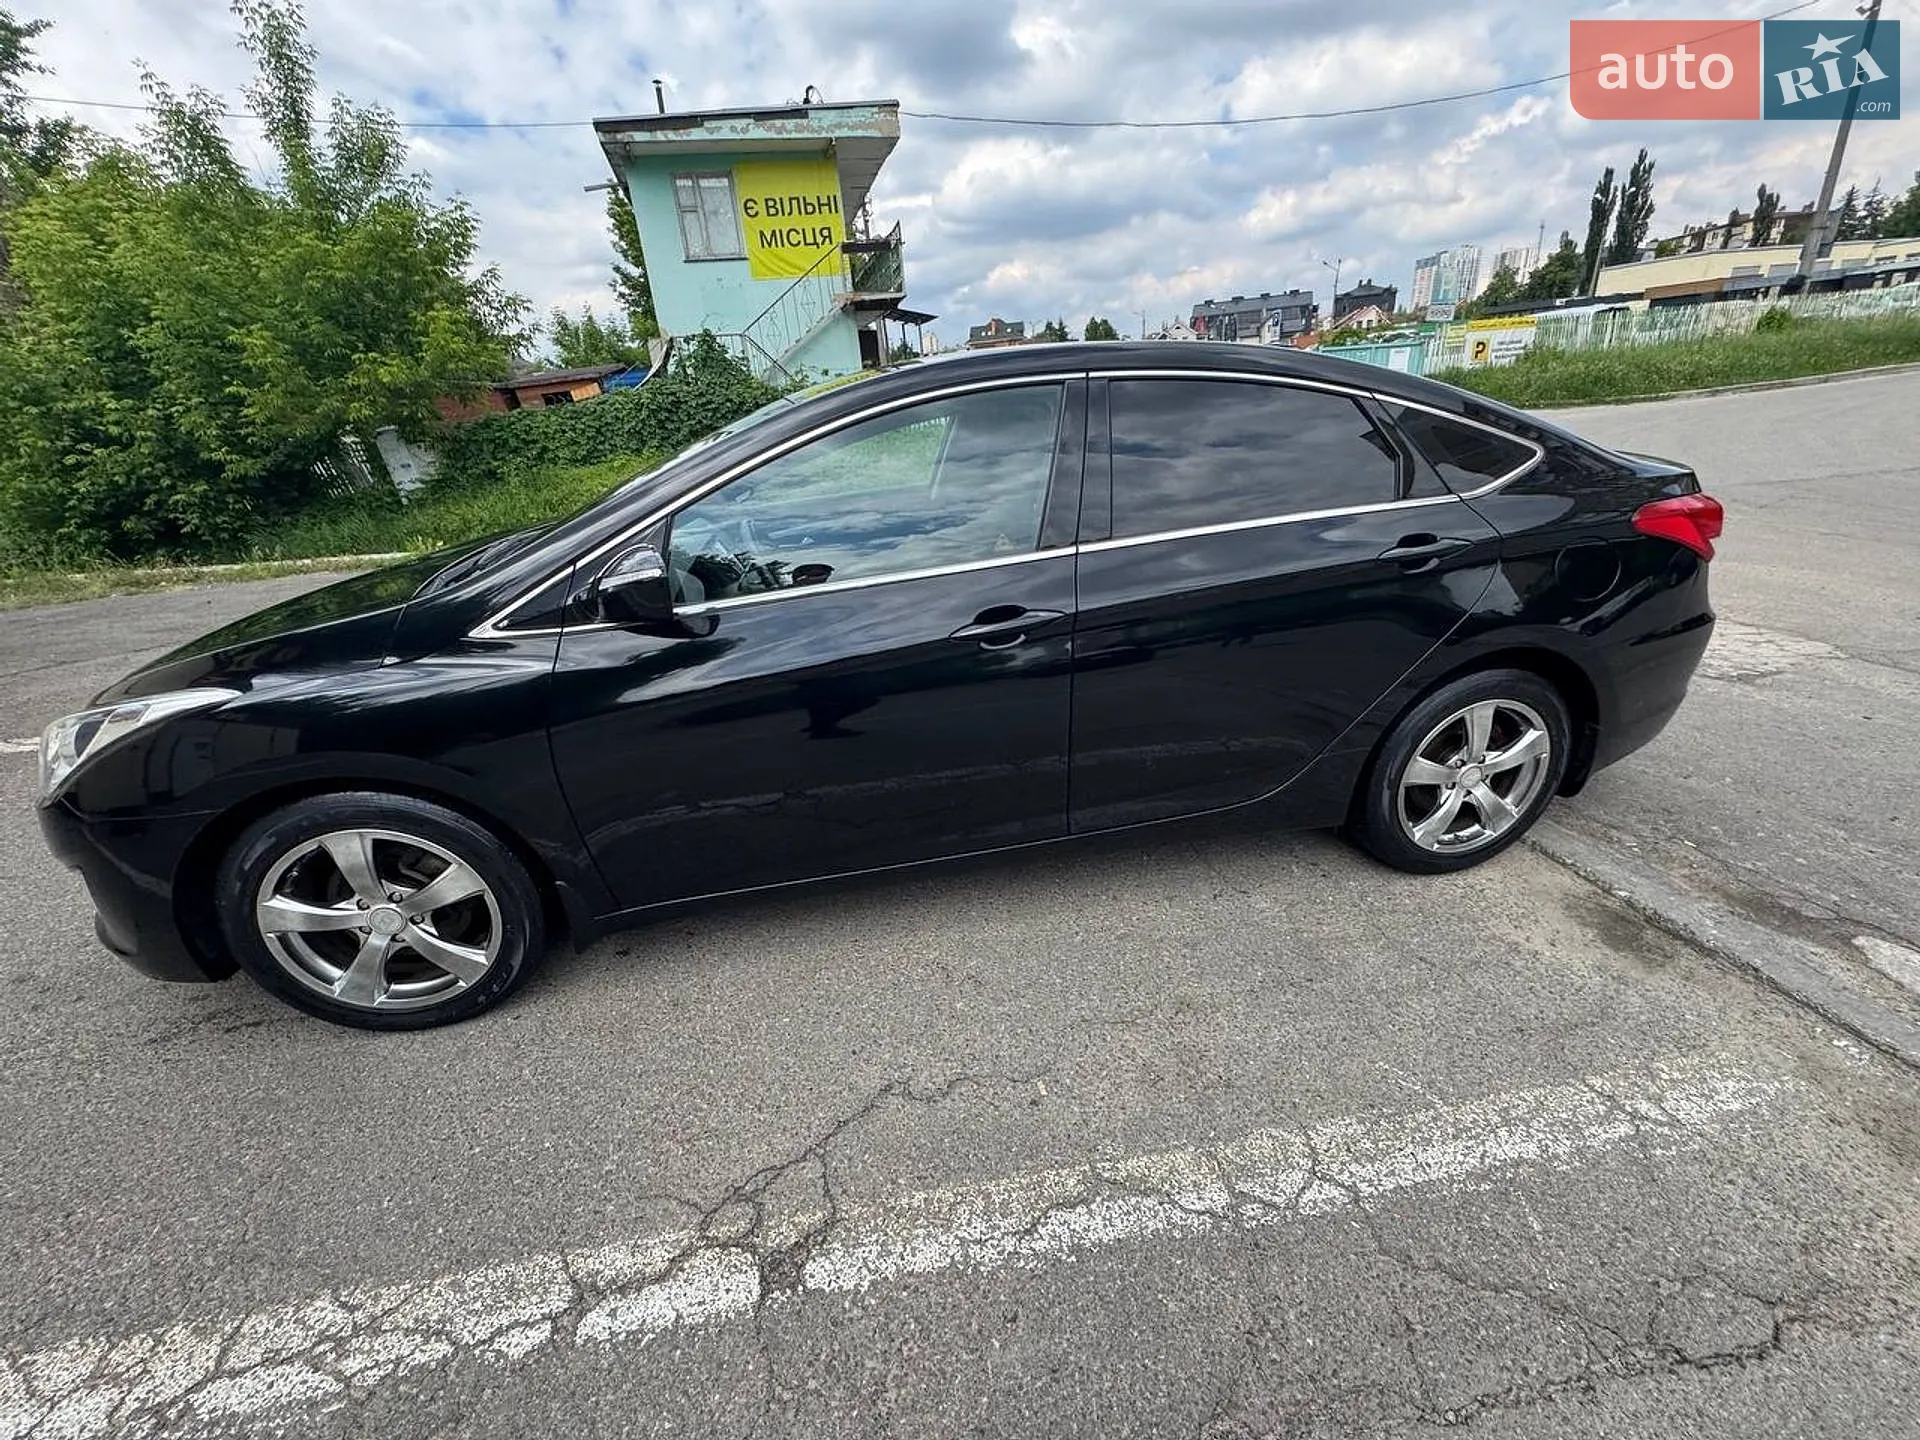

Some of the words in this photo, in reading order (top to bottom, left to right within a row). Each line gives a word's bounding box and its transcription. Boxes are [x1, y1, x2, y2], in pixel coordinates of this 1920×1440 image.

[743, 198, 759, 218] Є
[764, 194, 839, 217] ВІЛЬНІ
[759, 226, 833, 249] МІСЦЯ
